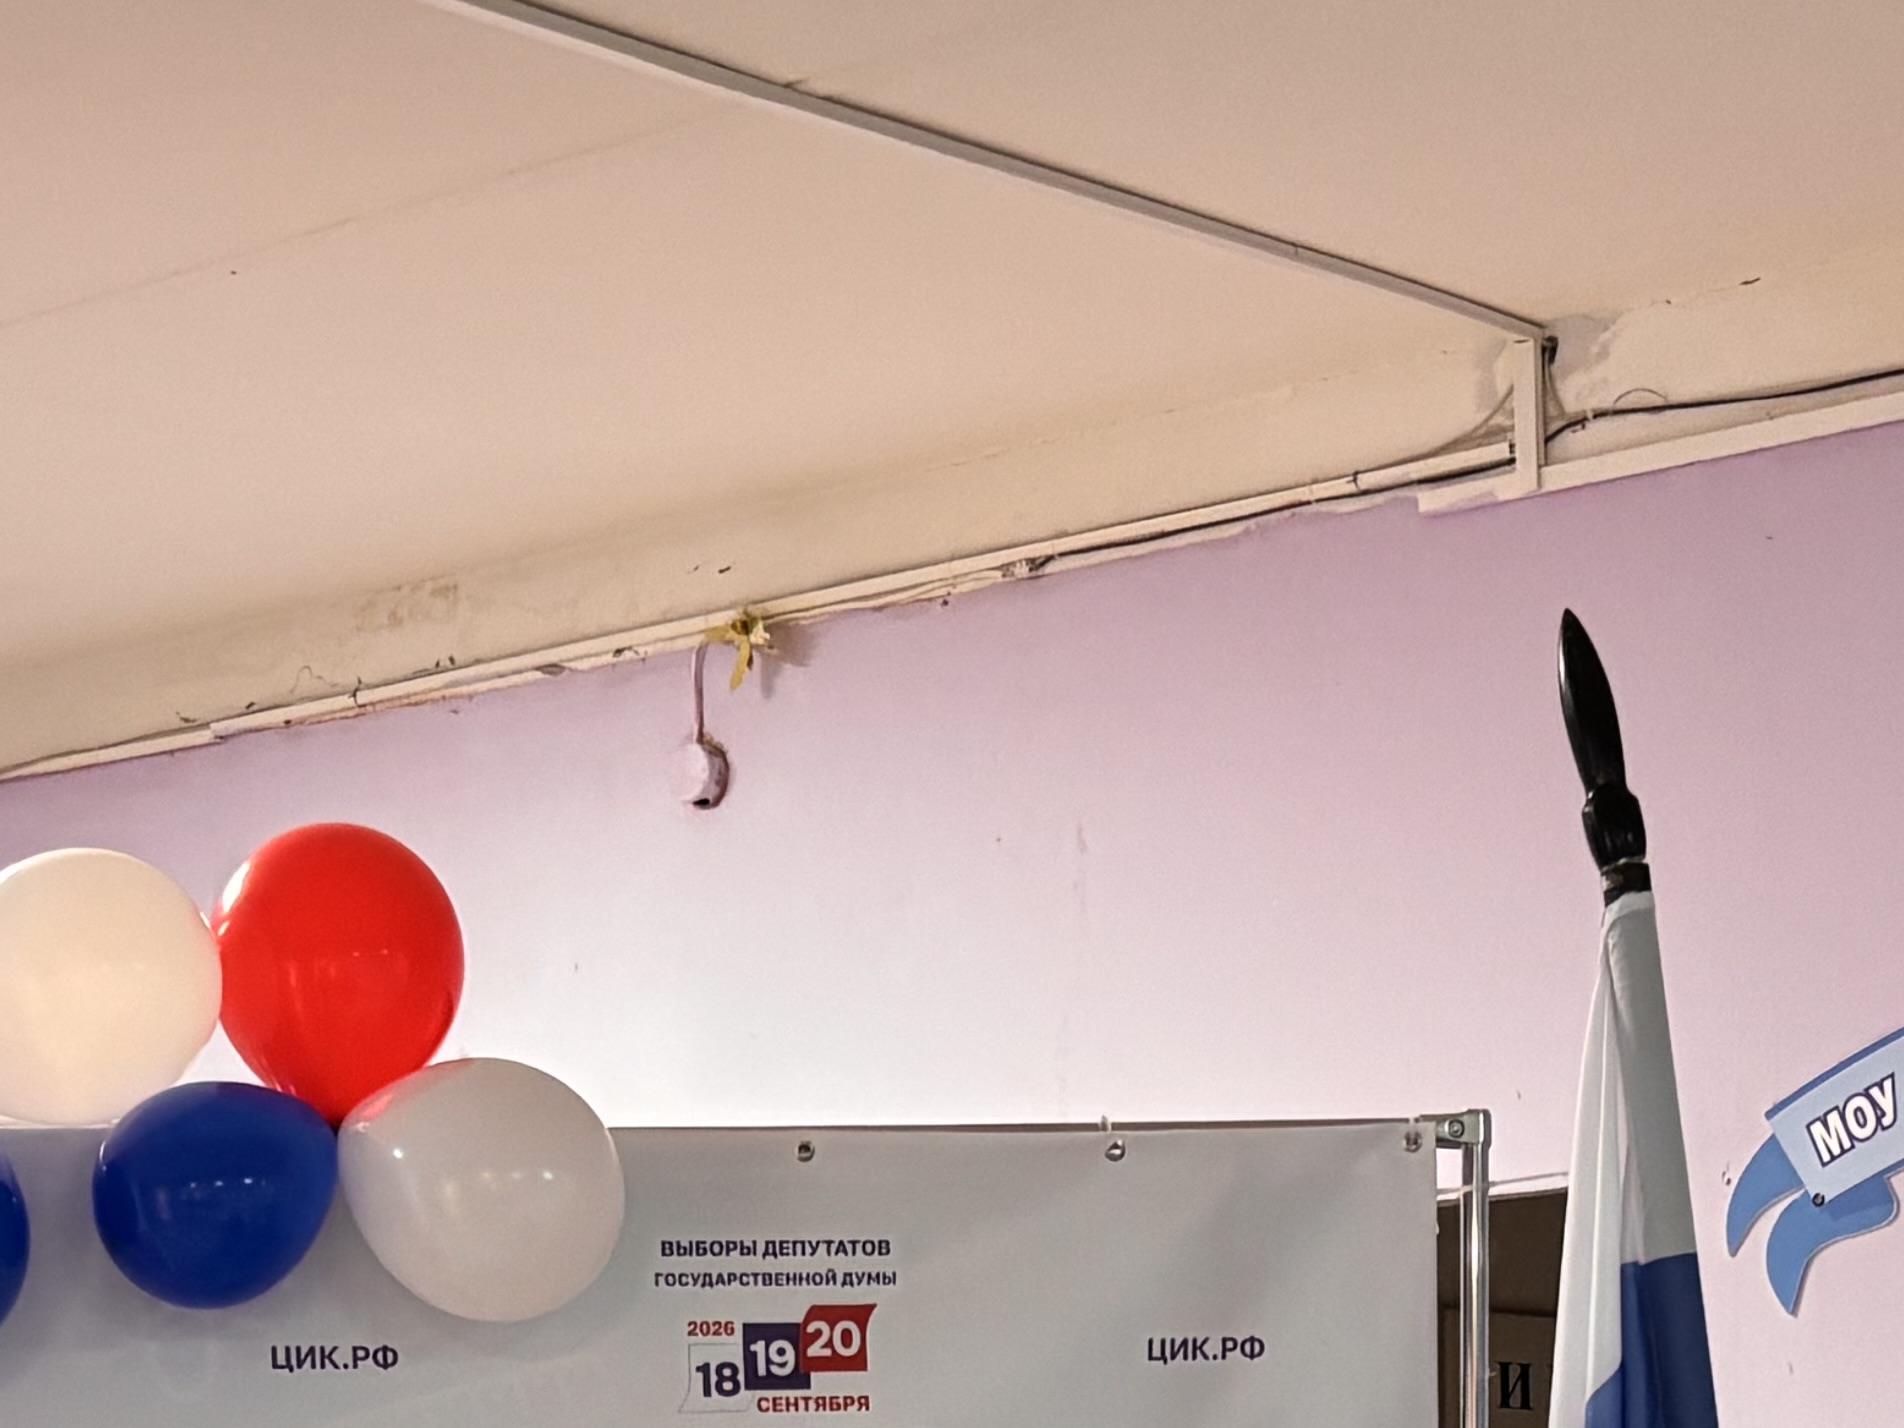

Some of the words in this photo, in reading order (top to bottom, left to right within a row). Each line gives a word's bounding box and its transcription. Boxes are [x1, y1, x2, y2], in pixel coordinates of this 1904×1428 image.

[1807, 1073, 1896, 1167] МОУ
[660, 1241, 757, 1257] ВЫБОРЫ
[762, 1240, 890, 1259] ДЕПУТАТОВ
[655, 1270, 837, 1289] ГОСУДАРСТВЕННОЙ
[841, 1271, 896, 1288] ДУМЫ
[687, 1321, 736, 1336] 2026
[806, 1320, 862, 1356] 20
[271, 1345, 398, 1373] ЦИК.РФ
[750, 1340, 795, 1376] 19
[1148, 1336, 1265, 1365] ЦИК.РФ
[696, 1361, 742, 1397] 18
[756, 1395, 870, 1413] СЕНТЯБРЯ
